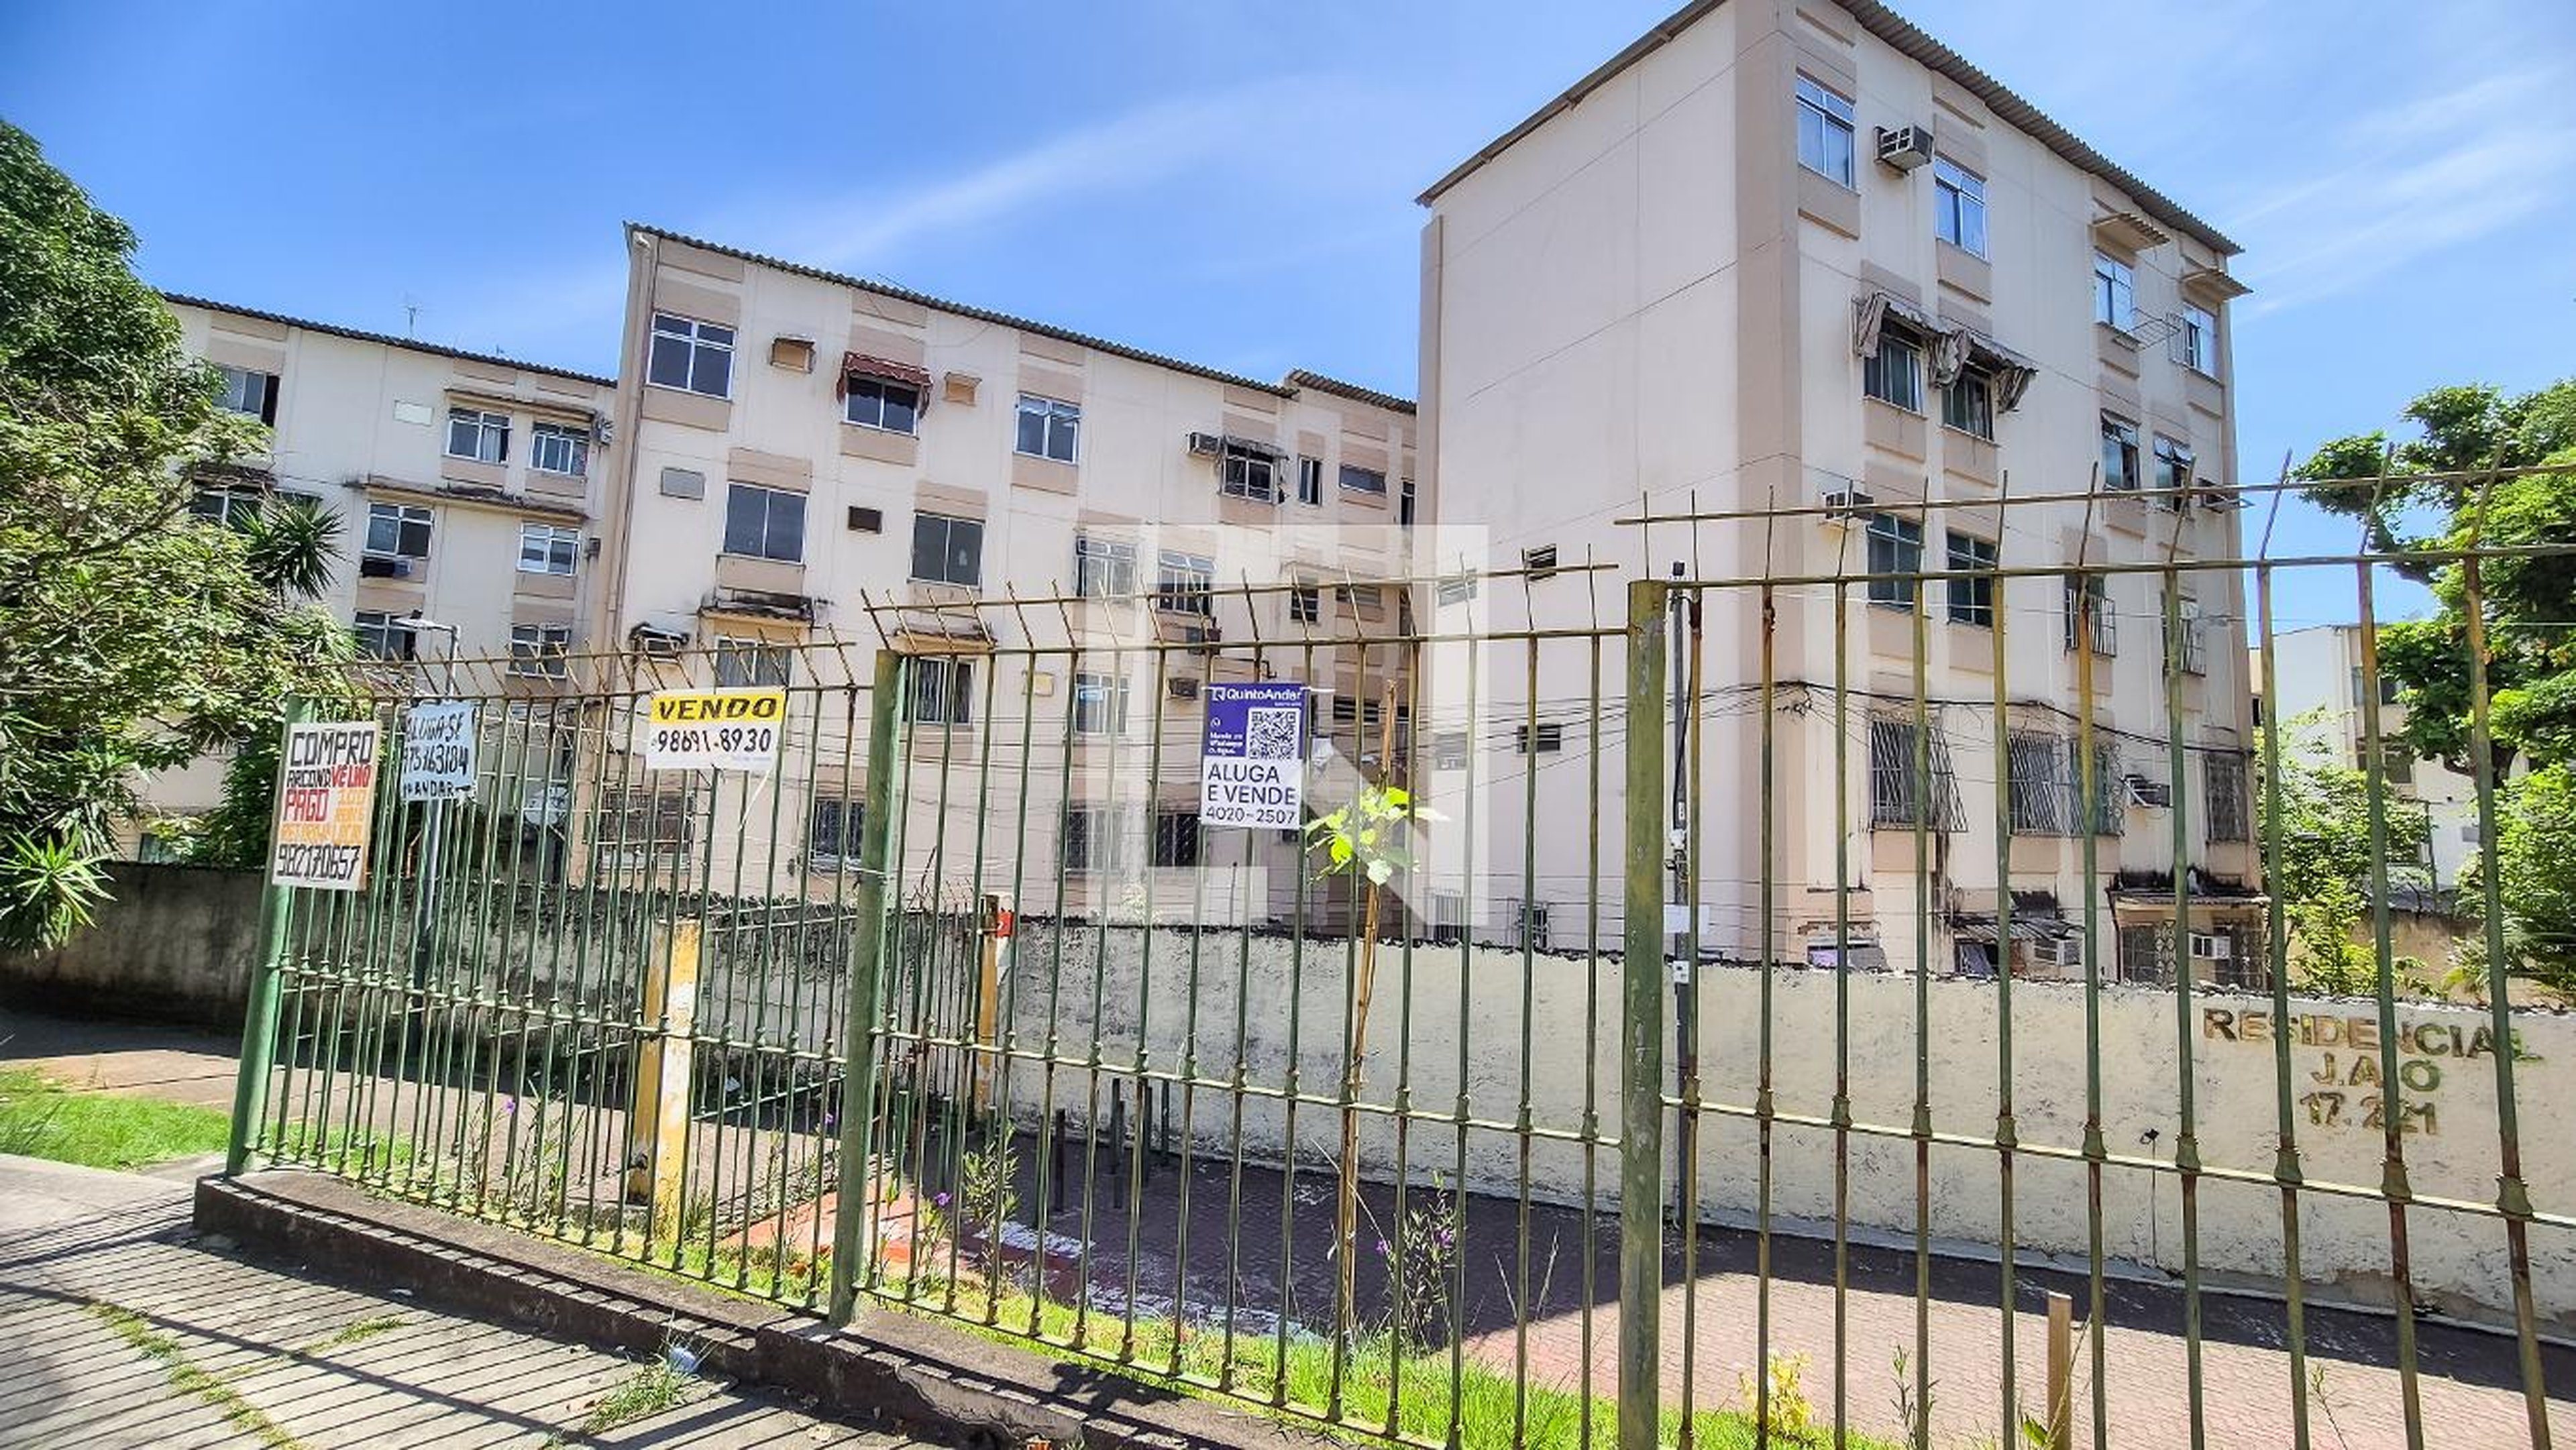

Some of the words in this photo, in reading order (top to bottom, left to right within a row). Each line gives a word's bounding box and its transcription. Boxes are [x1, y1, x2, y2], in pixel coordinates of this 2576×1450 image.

[1227, 688, 1302, 701] QuintoAndar
[659, 698, 777, 720] VENDO
[290, 730, 374, 766] COMPRO
[658, 728, 771, 752] 98691-8930
[1208, 763, 1280, 783] ALUGA
[283, 789, 329, 822] PAGO
[1208, 785, 1218, 801] E
[1224, 785, 1296, 805] VENDE
[1206, 806, 1295, 824] 4020-2507
